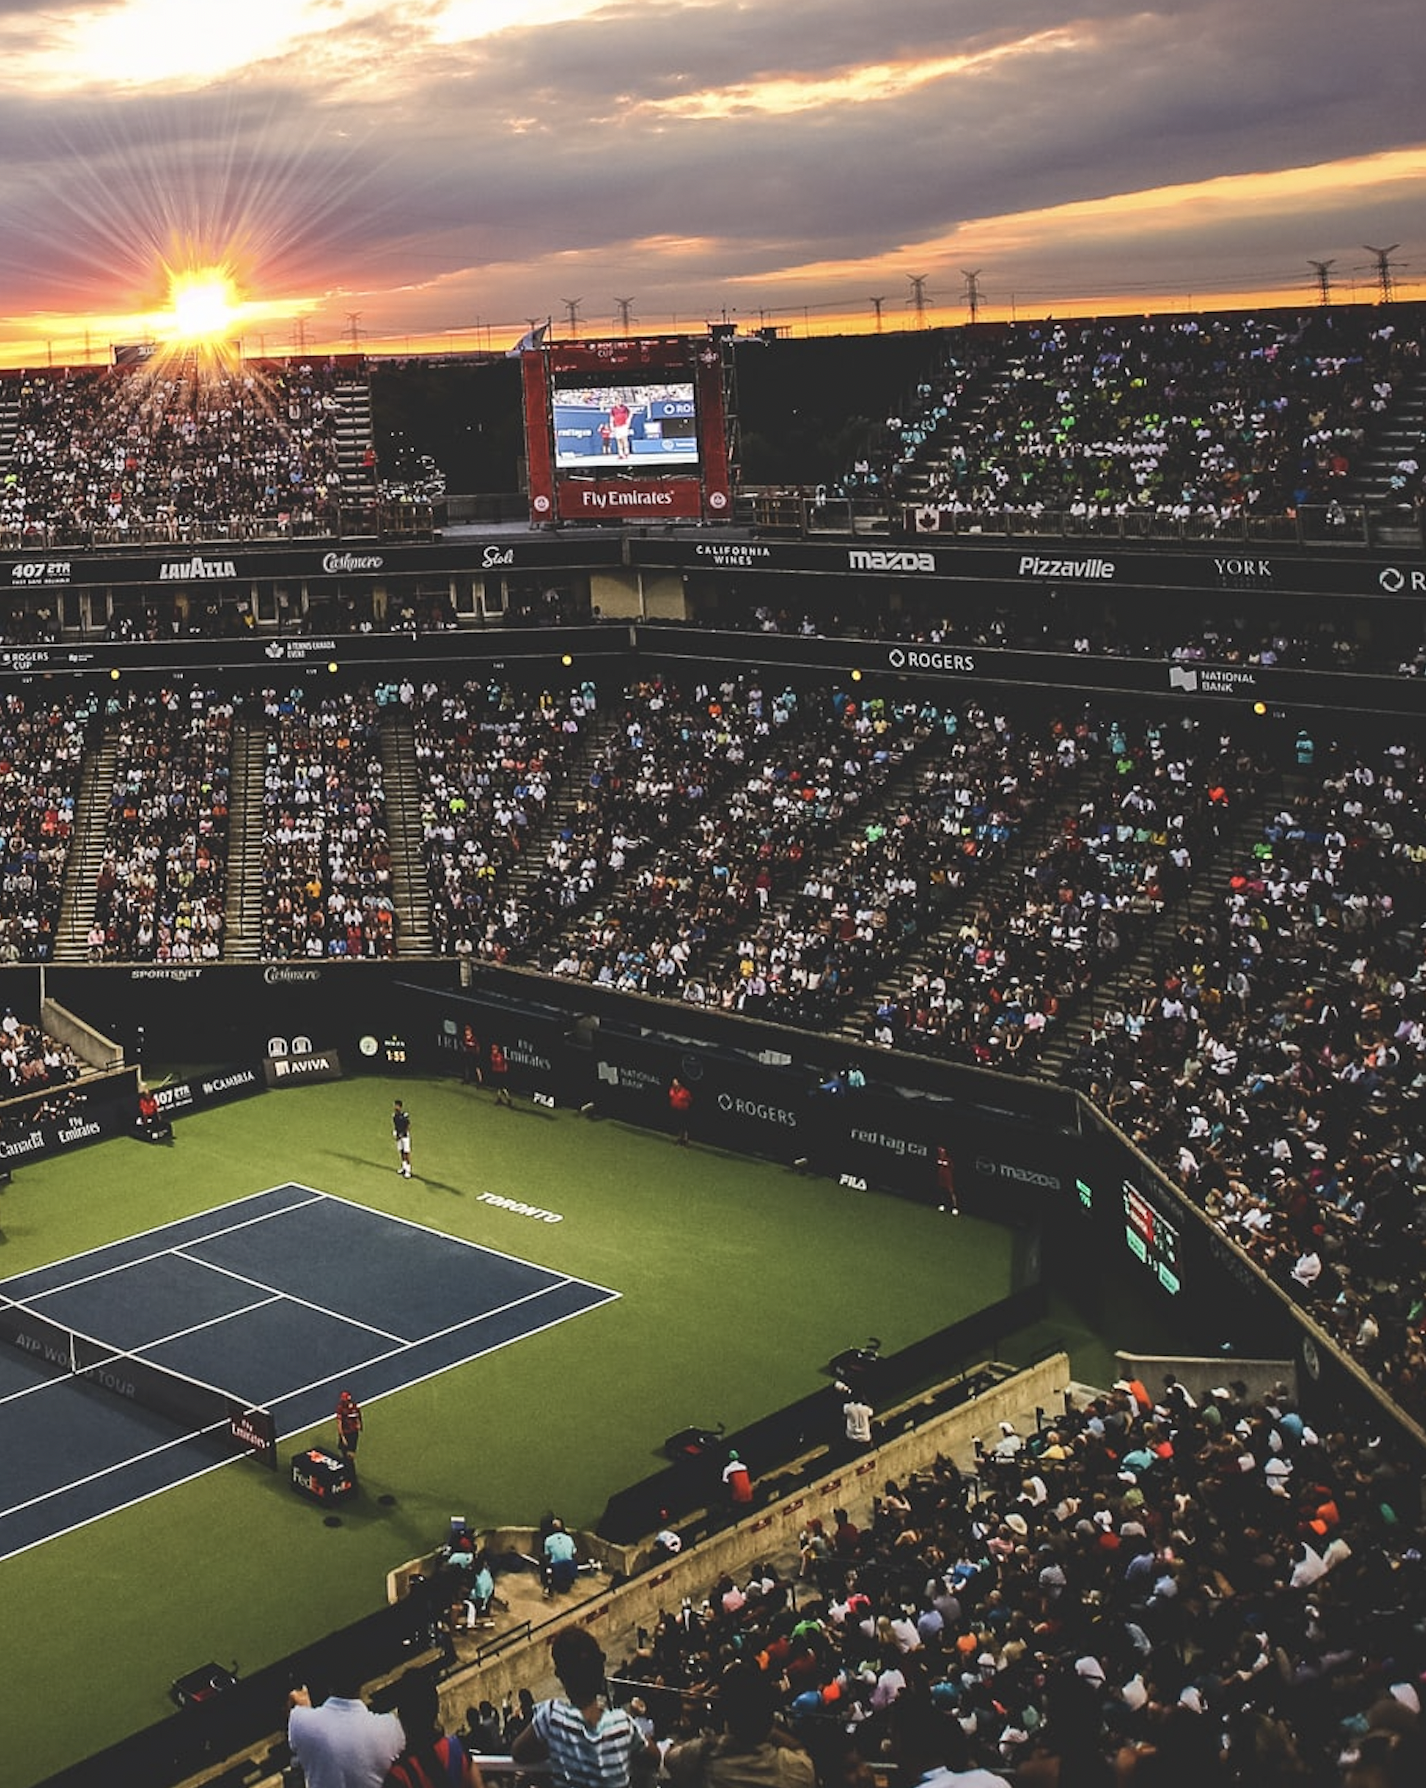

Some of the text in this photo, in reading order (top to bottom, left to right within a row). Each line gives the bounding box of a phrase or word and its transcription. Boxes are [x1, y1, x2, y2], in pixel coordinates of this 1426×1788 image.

[582, 490, 673, 509] Fly Emirates
[695, 545, 770, 557] CALIFORNIA
[714, 554, 752, 566] WINES
[11, 562, 71, 578] 407 ETR
[159, 557, 237, 579] LAVAZZA
[848, 550, 935, 572] mazda
[1018, 556, 1115, 579] Pizzaville
[1213, 558, 1272, 577] YORK
[11, 651, 49, 662] ROGERS
[12, 660, 33, 670] CUP
[908, 652, 974, 672] ROGERS
[1201, 671, 1256, 685] NATIONAL
[1201, 681, 1234, 693] BANK
[131, 969, 203, 980] SPORTSNET
[291, 1058, 330, 1074] AVIVA
[503, 1046, 552, 1071] Emirates
[212, 1070, 256, 1092] CAMBRIA
[620, 1067, 662, 1086] NATIONAL
[533, 1091, 555, 1108] FILA
[736, 1098, 797, 1129] ROGERS
[57, 1121, 101, 1144] Emirates
[839, 1173, 867, 1191] FILA
[1000, 1164, 1061, 1190] mazda
[476, 1191, 564, 1223] TORONTO
[15, 1333, 42, 1353] ATP
[98, 1369, 136, 1398] TOUR
[231, 1422, 266, 1450] Emirates
[292, 1466, 325, 1497] FedEx
